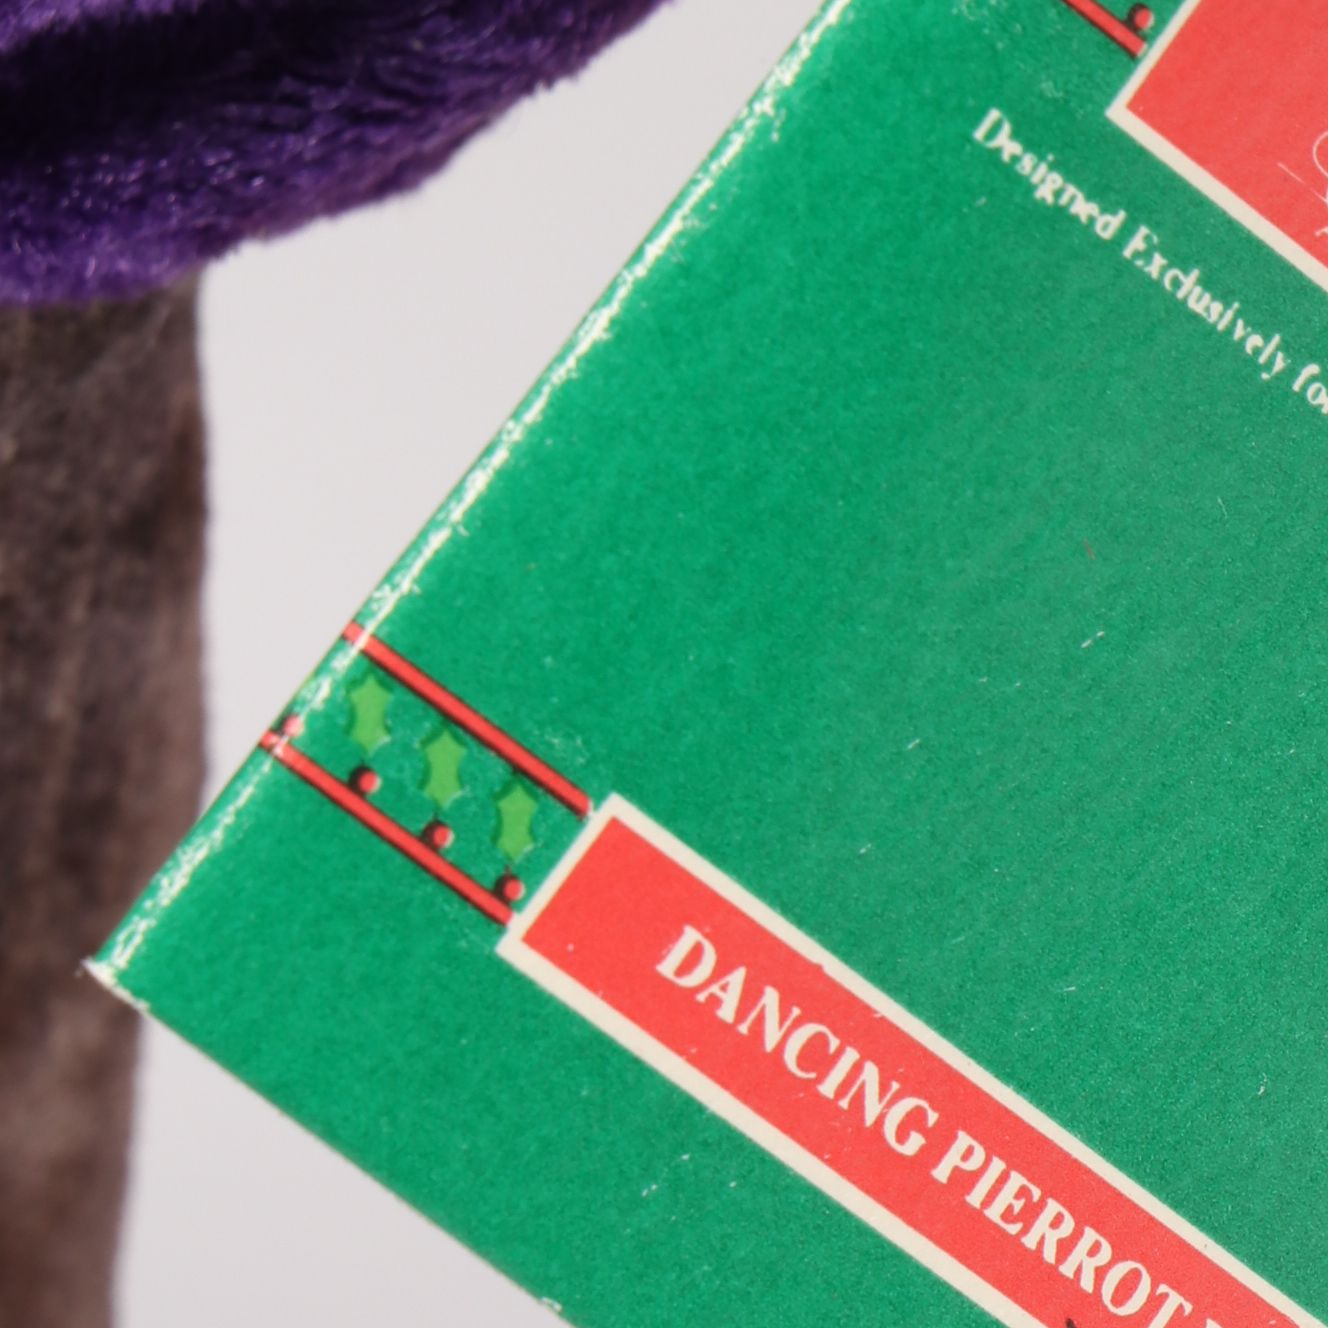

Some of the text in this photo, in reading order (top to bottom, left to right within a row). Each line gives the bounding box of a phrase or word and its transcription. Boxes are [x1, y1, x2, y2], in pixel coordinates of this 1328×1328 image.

[973, 107, 1127, 240] Designed
[1122, 226, 1292, 381] Exclusively
[655, 925, 940, 1159] DANCING
